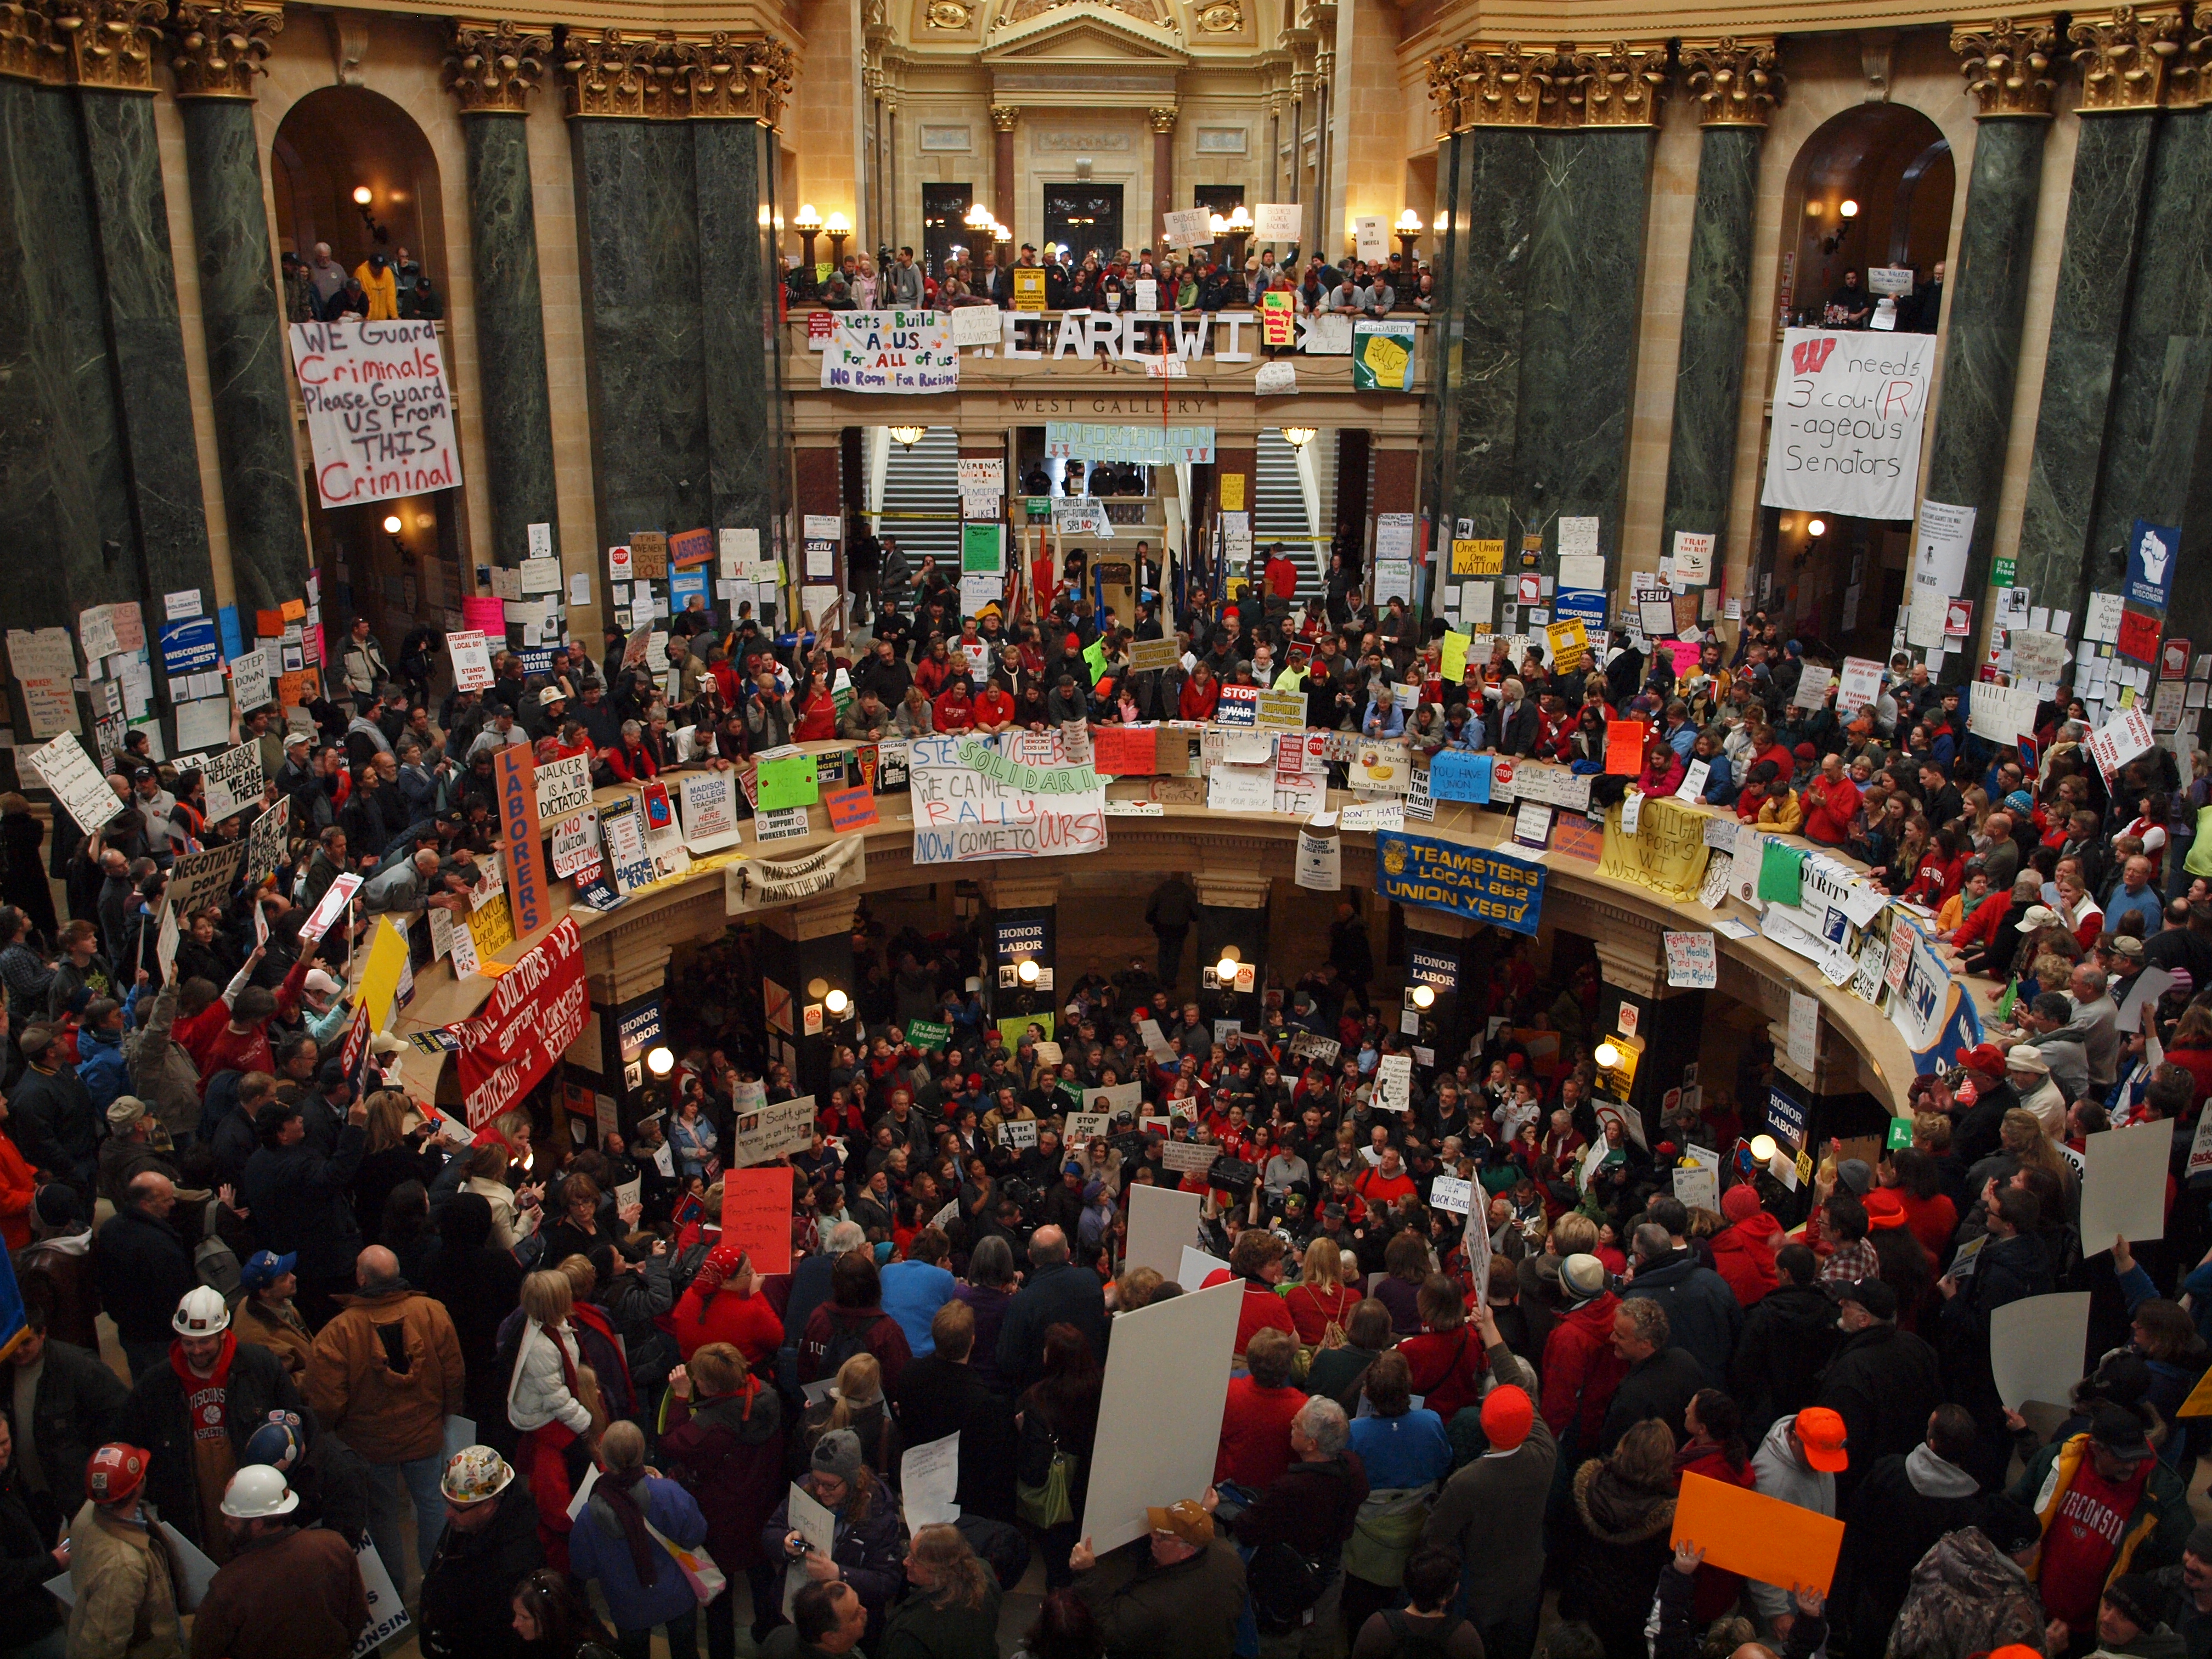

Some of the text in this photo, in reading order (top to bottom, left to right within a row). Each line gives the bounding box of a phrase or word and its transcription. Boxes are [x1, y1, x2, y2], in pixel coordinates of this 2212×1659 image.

[1172, 212, 1200, 224] BUDGET
[1181, 222, 1199, 232] BILL
[1174, 230, 1211, 245] BULLYING!
[972, 307, 996, 316] STATE
[895, 311, 935, 329] Build
[963, 319, 992, 329] MOTTO
[1359, 324, 1410, 333] SOLIDARITY
[300, 321, 436, 353] WE Guard
[866, 332, 923, 351] A U.S.
[299, 347, 439, 384] Criminals
[843, 350, 865, 366] For
[876, 353, 906, 368] ALL
[915, 351, 932, 365] of
[1848, 352, 1921, 376] needs
[831, 368, 850, 385] NO
[303, 377, 444, 414] Please Guard
[1787, 380, 1814, 408] 3
[1014, 399, 1205, 413] WEST GALLERY
[344, 403, 445, 432] US From
[1051, 421, 1211, 447] INFORMATION
[352, 426, 436, 461] THIS
[1074, 444, 1182, 466] STATION
[1786, 445, 1900, 477] Senators
[320, 448, 453, 501] Criminal
[639, 534, 656, 542] THE
[631, 544, 666, 554] MOVEMENT
[672, 534, 713, 560] LABORERS
[807, 542, 832, 551] SEIU
[1455, 541, 1503, 552] One Union
[613, 552, 628, 562] STOP
[632, 554, 667, 563] LOVES
[1470, 554, 1486, 562] One
[635, 563, 666, 577] YOU
[1458, 560, 1503, 574] NATION!
[2133, 582, 2153, 592] FIGHTING
[2132, 588, 2163, 603] WISCONSIN
[167, 600, 201, 610] SOLIDARITY
[1547, 618, 1581, 632] STEAMFITTERS
[448, 632, 484, 641] STEAMFITTERS
[165, 642, 216, 661] WISCONSIN
[1555, 642, 1585, 654] SUPPORTS
[193, 652, 217, 663] BEST
[239, 653, 264, 673] STEP
[235, 669, 264, 688] DOWN
[459, 680, 494, 690] WISCONSIN
[1222, 687, 1257, 699] STOP
[1259, 692, 1305, 703] Union Pipetrades
[1226, 706, 1251, 718] WAR
[1262, 702, 1300, 715] SUPPORTS
[1257, 713, 1304, 727] Workers Rights
[204, 742, 255, 775] LIKE A GOOD
[208, 755, 256, 786] NEIGHBOR
[534, 758, 583, 782] WALKER
[1413, 769, 1429, 782] Tax
[227, 766, 262, 792] WE ARE
[232, 780, 263, 805] THERE
[548, 781, 568, 797] IS A
[690, 780, 725, 794] MADISON
[1410, 781, 1427, 794] The
[690, 788, 726, 803] COLLEGE
[693, 797, 726, 809] TEACHERS
[1408, 793, 1434, 808] Rich!
[540, 789, 590, 818] DICTATOR
[698, 811, 721, 822] HERE
[767, 808, 794, 819] WORKERS
[926, 800, 1037, 827] RALLY
[1344, 806, 1403, 818] DON'T HATE
[564, 817, 580, 836] NO
[699, 820, 720, 828] SUPPORT
[708, 823, 731, 834] STUDENTS
[769, 818, 794, 829] SUPPORT
[505, 753, 538, 931] LABORERS
[759, 827, 808, 842] WORKERS RIGHTS
[917, 808, 1105, 861] NOW COME TO OURS!
[1306, 836, 1330, 845] UNIONS
[558, 832, 586, 854] UNION
[1301, 844, 1335, 855] TOGETHER
[1307, 842, 1328, 850] STAND
[173, 841, 243, 882] NEGOTIATE
[554, 844, 599, 874] BUSTING
[1411, 845, 1538, 887] TEAMSTERS
[191, 869, 230, 892] DON'T
[762, 866, 783, 882] IRAQ
[760, 872, 835, 903] AGAINST THE WAR
[1419, 866, 1528, 901] LOCAL 662
[1386, 881, 1507, 919] UNION YES
[998, 926, 1042, 939] HONOR
[998, 940, 1043, 953] LABOR
[1666, 933, 1708, 948] Fighting for
[1674, 947, 1709, 958] my Health
[1413, 953, 1457, 972] HONOR
[1692, 961, 1703, 970] my
[1412, 968, 1455, 986] LABOR
[1670, 969, 1715, 984] Union Rights
[498, 998, 539, 1055] SUPPORT
[620, 1007, 659, 1035] HONOR
[913, 1022, 947, 1034] It's About
[543, 1007, 583, 1063] RIGHTS
[623, 1023, 660, 1051] LABOR
[911, 1028, 945, 1040] Freedom!
[466, 1057, 521, 1129] MEDICAID
[1176, 1099, 1193, 1109] SAVE
[1770, 1093, 1802, 1125] HONOR
[795, 1108, 812, 1120] your
[1768, 1110, 1801, 1142] LABOR
[739, 1136, 763, 1147] money
[784, 1124, 796, 1133] the
[1800, 1152, 1809, 1167] FOR
[1797, 1160, 1809, 1178] SALE
[2057, 1489, 2125, 1544] WISCONSIN
